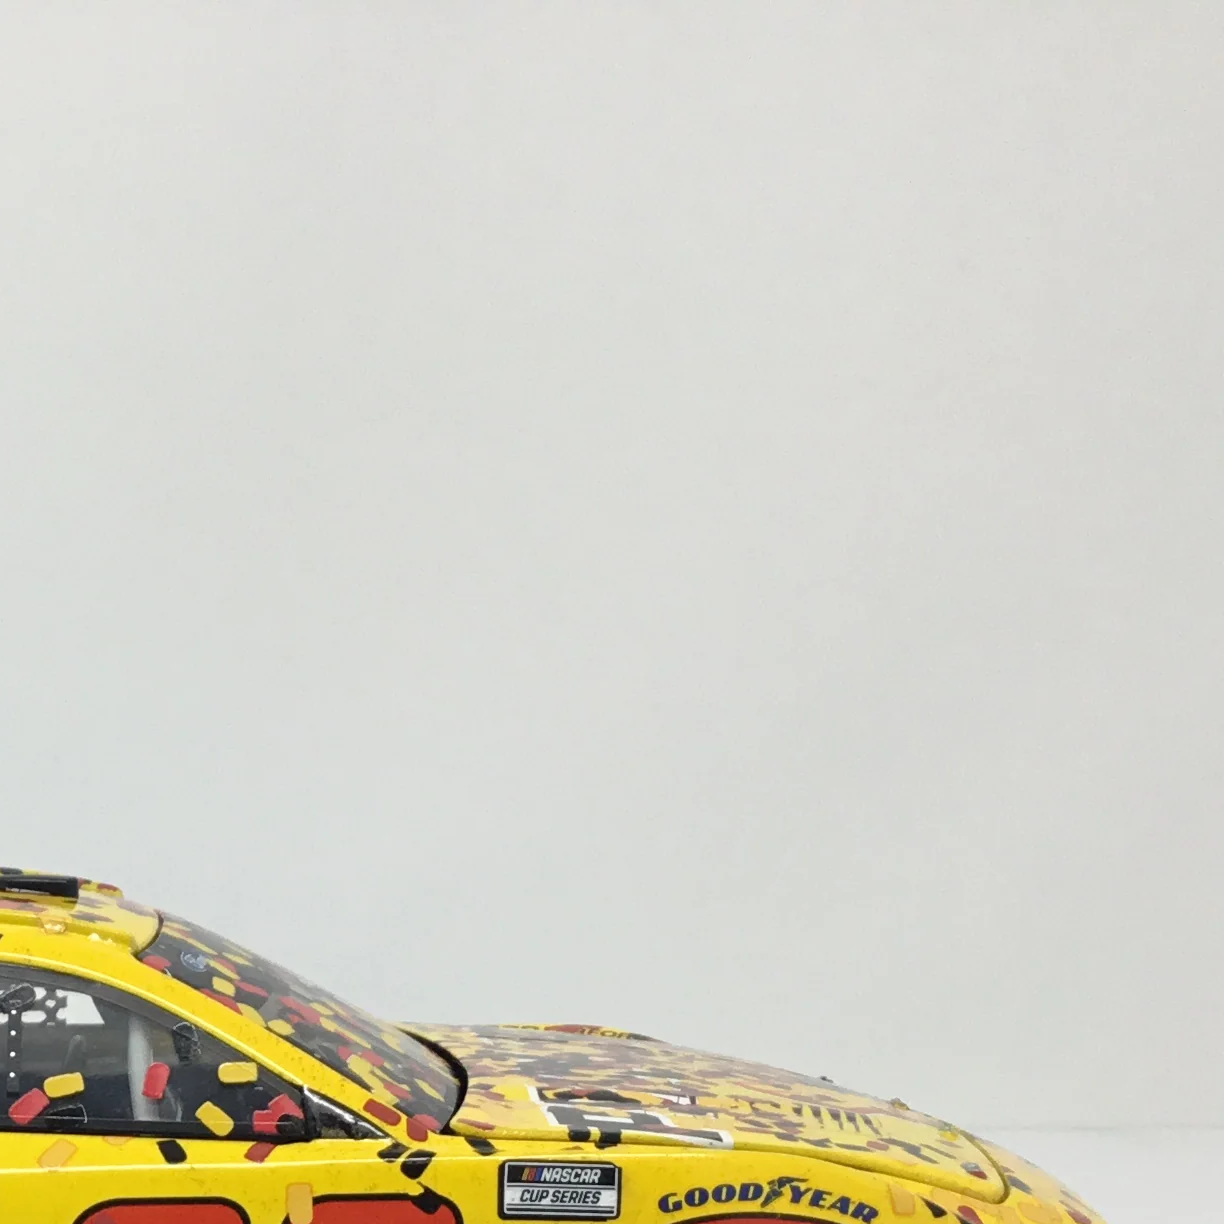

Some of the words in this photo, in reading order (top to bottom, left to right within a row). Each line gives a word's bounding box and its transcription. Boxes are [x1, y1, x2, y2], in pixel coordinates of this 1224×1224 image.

[540, 1167, 601, 1184] NASCAR
[520, 1189, 549, 1203] CUP
[550, 1191, 602, 1205] SERIES
